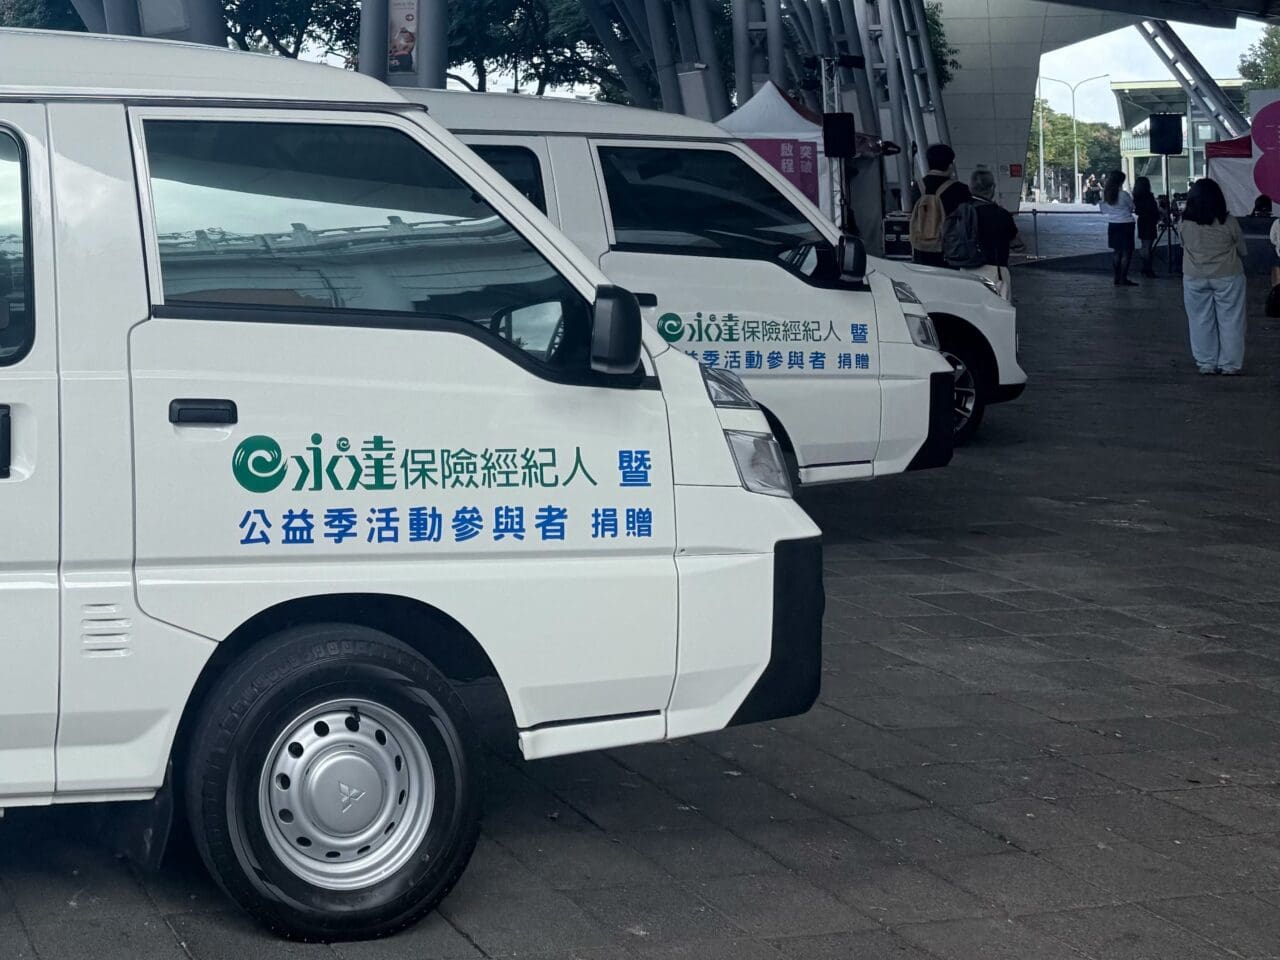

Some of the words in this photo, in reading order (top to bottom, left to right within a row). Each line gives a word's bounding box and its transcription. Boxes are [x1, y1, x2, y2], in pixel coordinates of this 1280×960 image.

[850, 323, 869, 344] 暨
[684, 350, 827, 370] 季活動參與者
[837, 352, 870, 370] 捐贈
[290, 433, 598, 492] 永達保險經紀人
[618, 449, 652, 487] 暨
[238, 504, 568, 545] 公益季活動參與者
[591, 507, 652, 539] 捐贈
